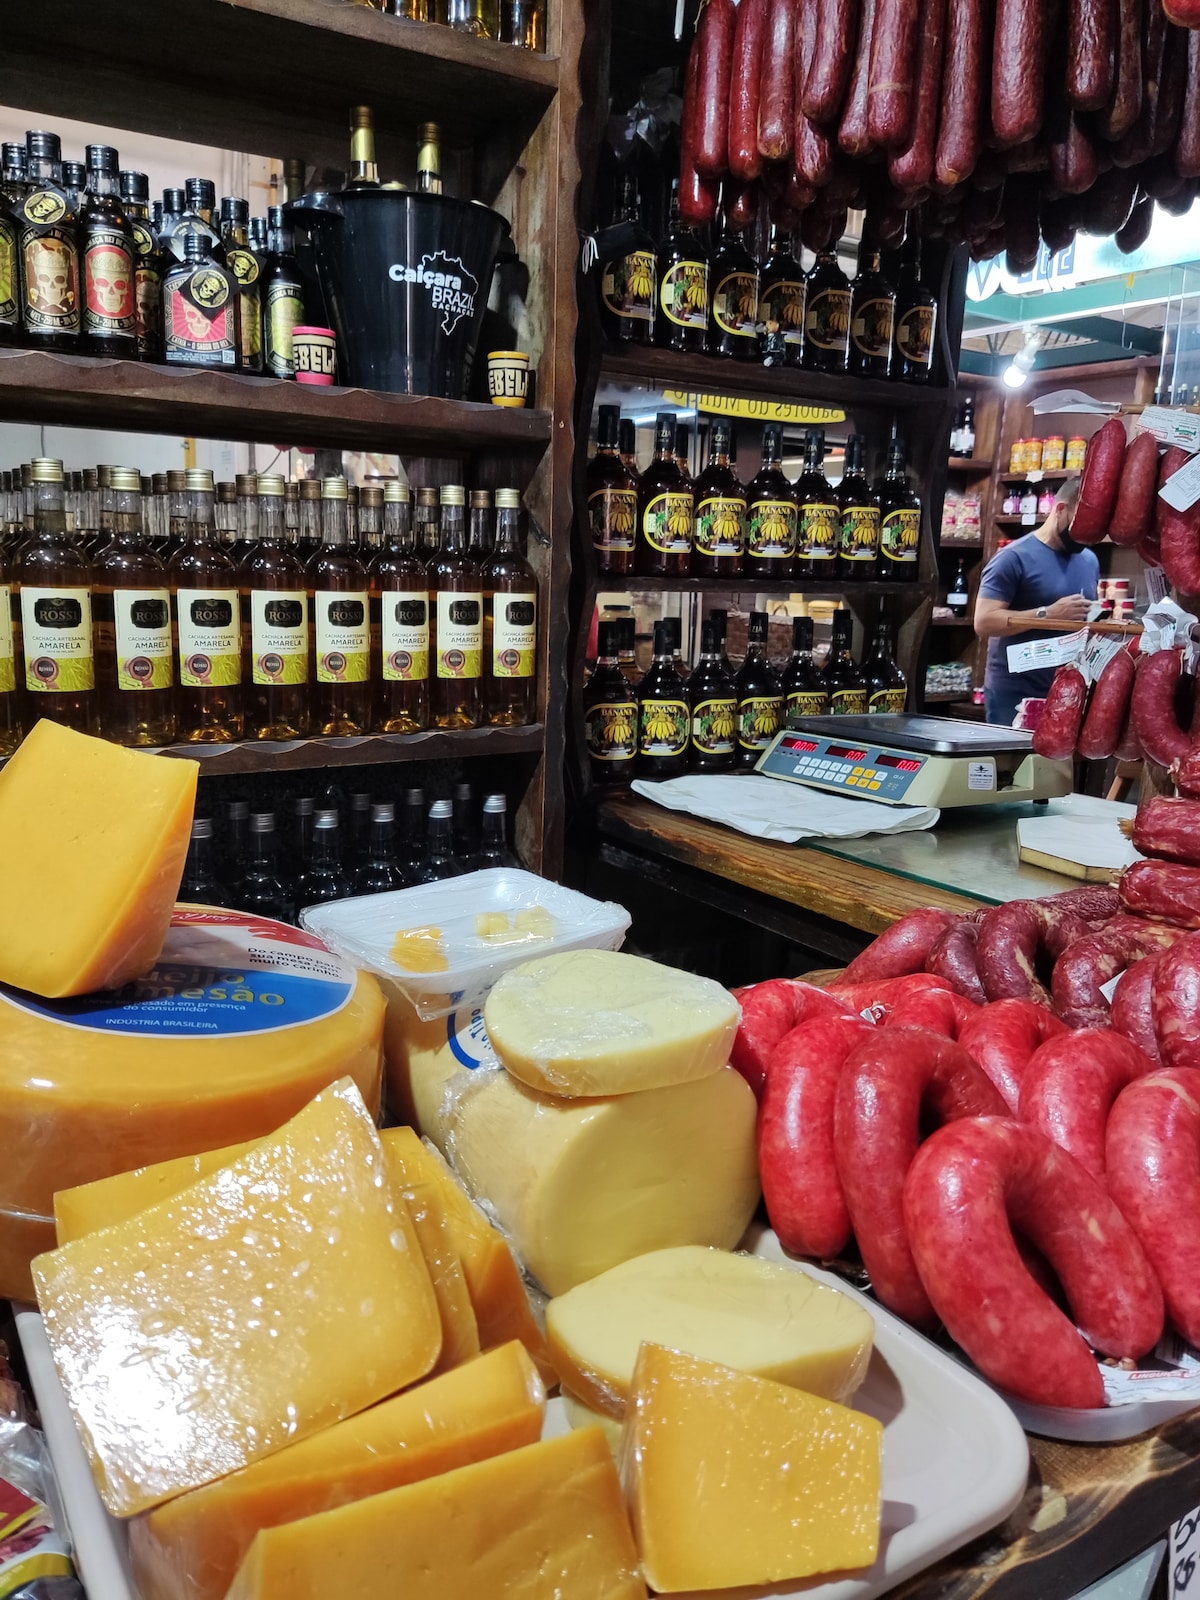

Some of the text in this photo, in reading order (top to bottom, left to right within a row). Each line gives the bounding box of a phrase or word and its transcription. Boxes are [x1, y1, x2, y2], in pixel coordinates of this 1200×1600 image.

[388, 264, 462, 290] Caiçara
[432, 286, 474, 311] BRAZIL
[40, 610, 78, 622] ROSSI
[195, 610, 228, 621] ROSSI
[38, 642, 82, 650] AMARELA
[645, 704, 678, 714] BANANA
[270, 950, 313, 962] campo
[316, 960, 342, 970] para
[277, 956, 311, 966] mesa
[249, 958, 342, 979] muito carinho.
[141, 1004, 208, 1012] consumidor
[198, 1002, 246, 1011] presença
[106, 1018, 218, 1029] INDÚSTRIA BRASILEIRA
